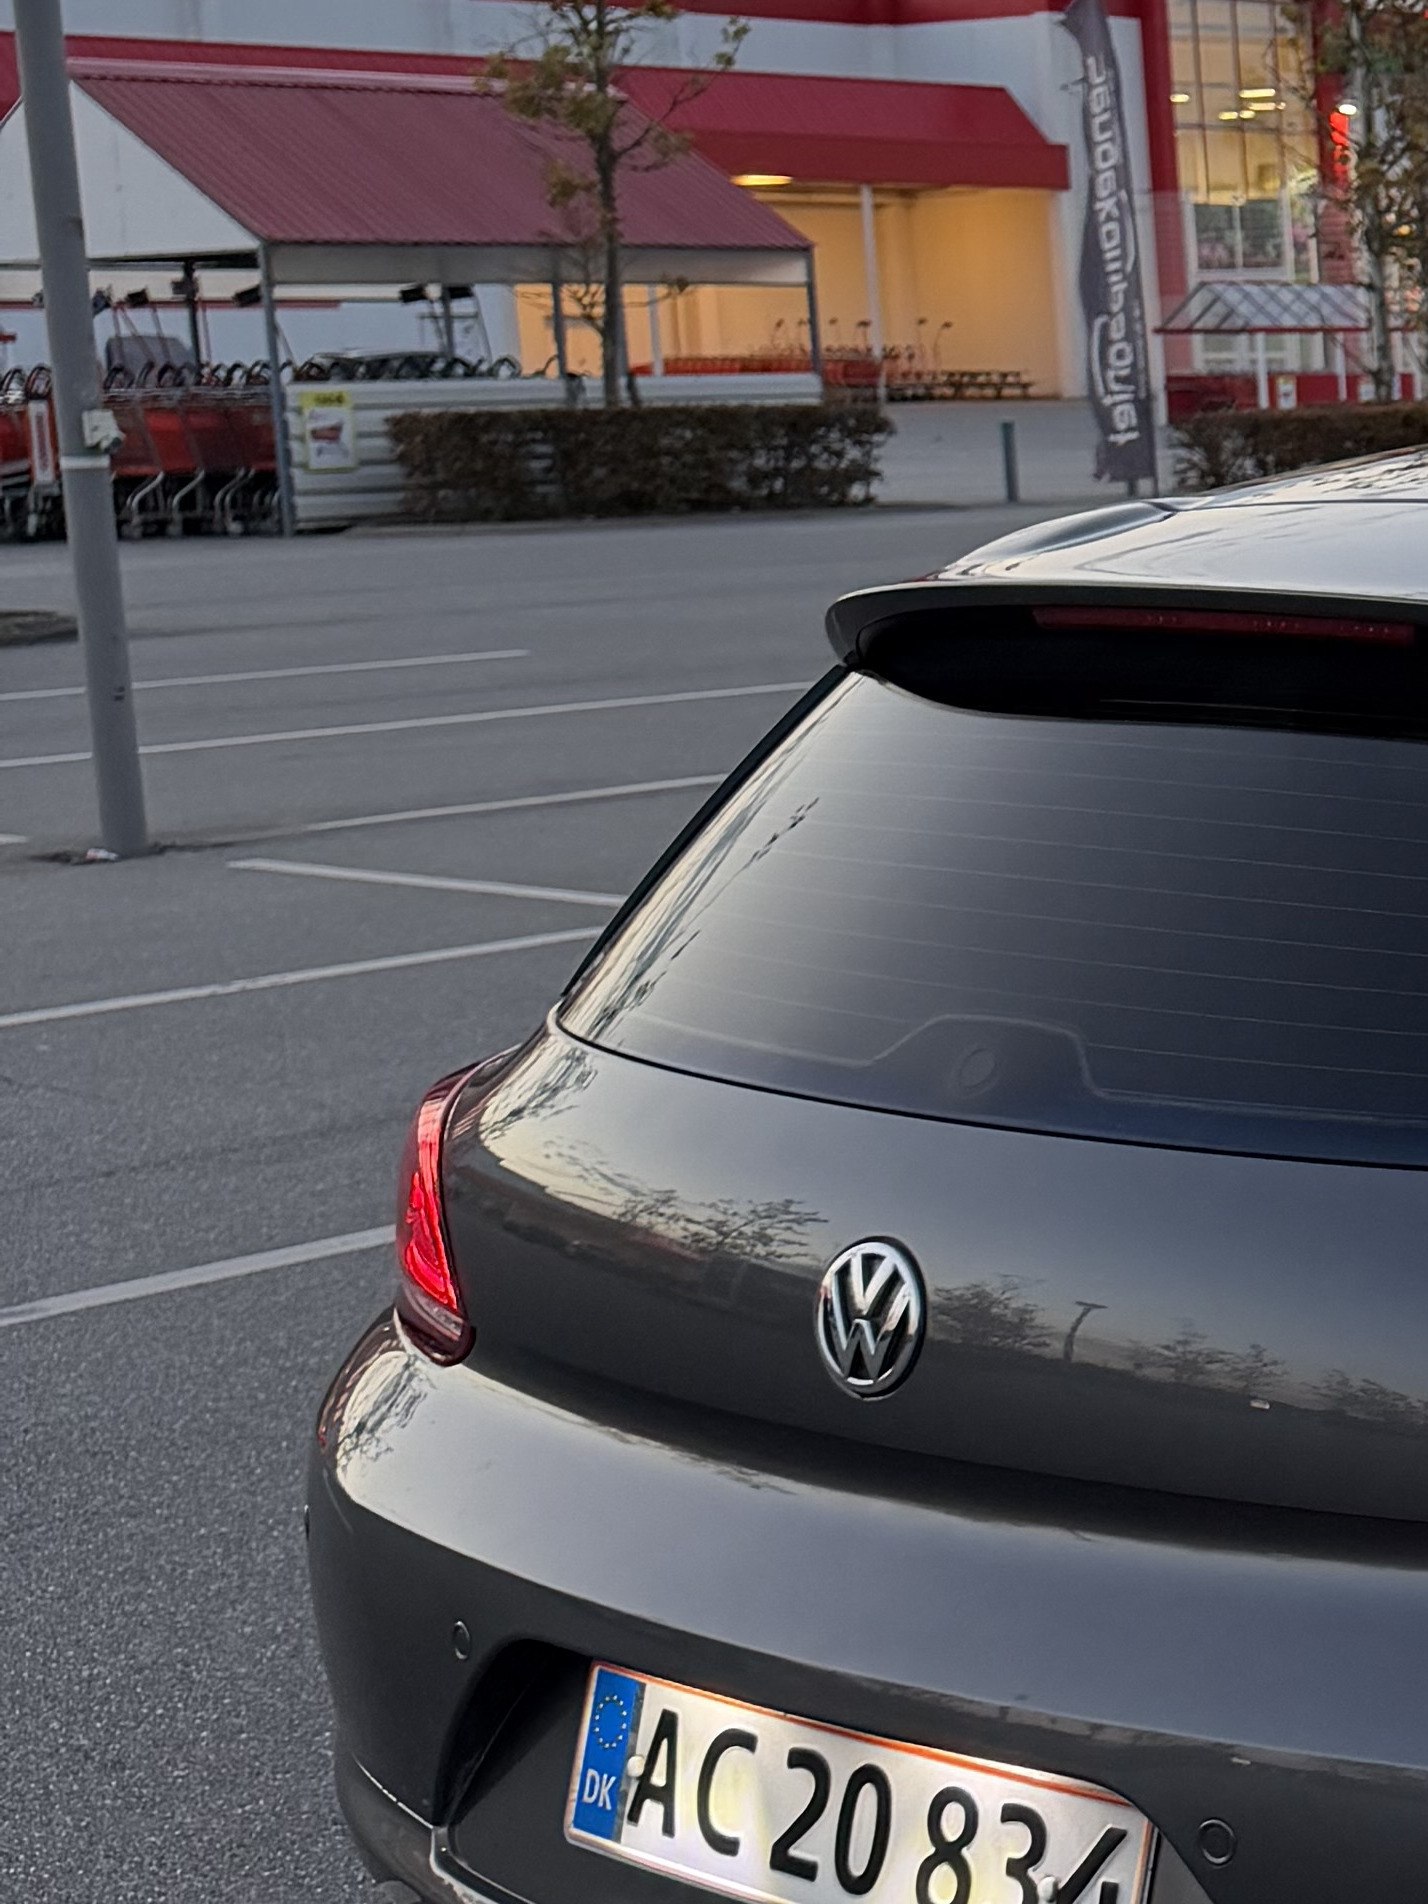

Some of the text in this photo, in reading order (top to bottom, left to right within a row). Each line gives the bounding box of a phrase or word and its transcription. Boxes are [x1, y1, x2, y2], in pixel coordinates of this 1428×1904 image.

[582, 1767, 616, 1810] DK
[627, 1708, 758, 1856] AC
[769, 1746, 893, 1896] 20
